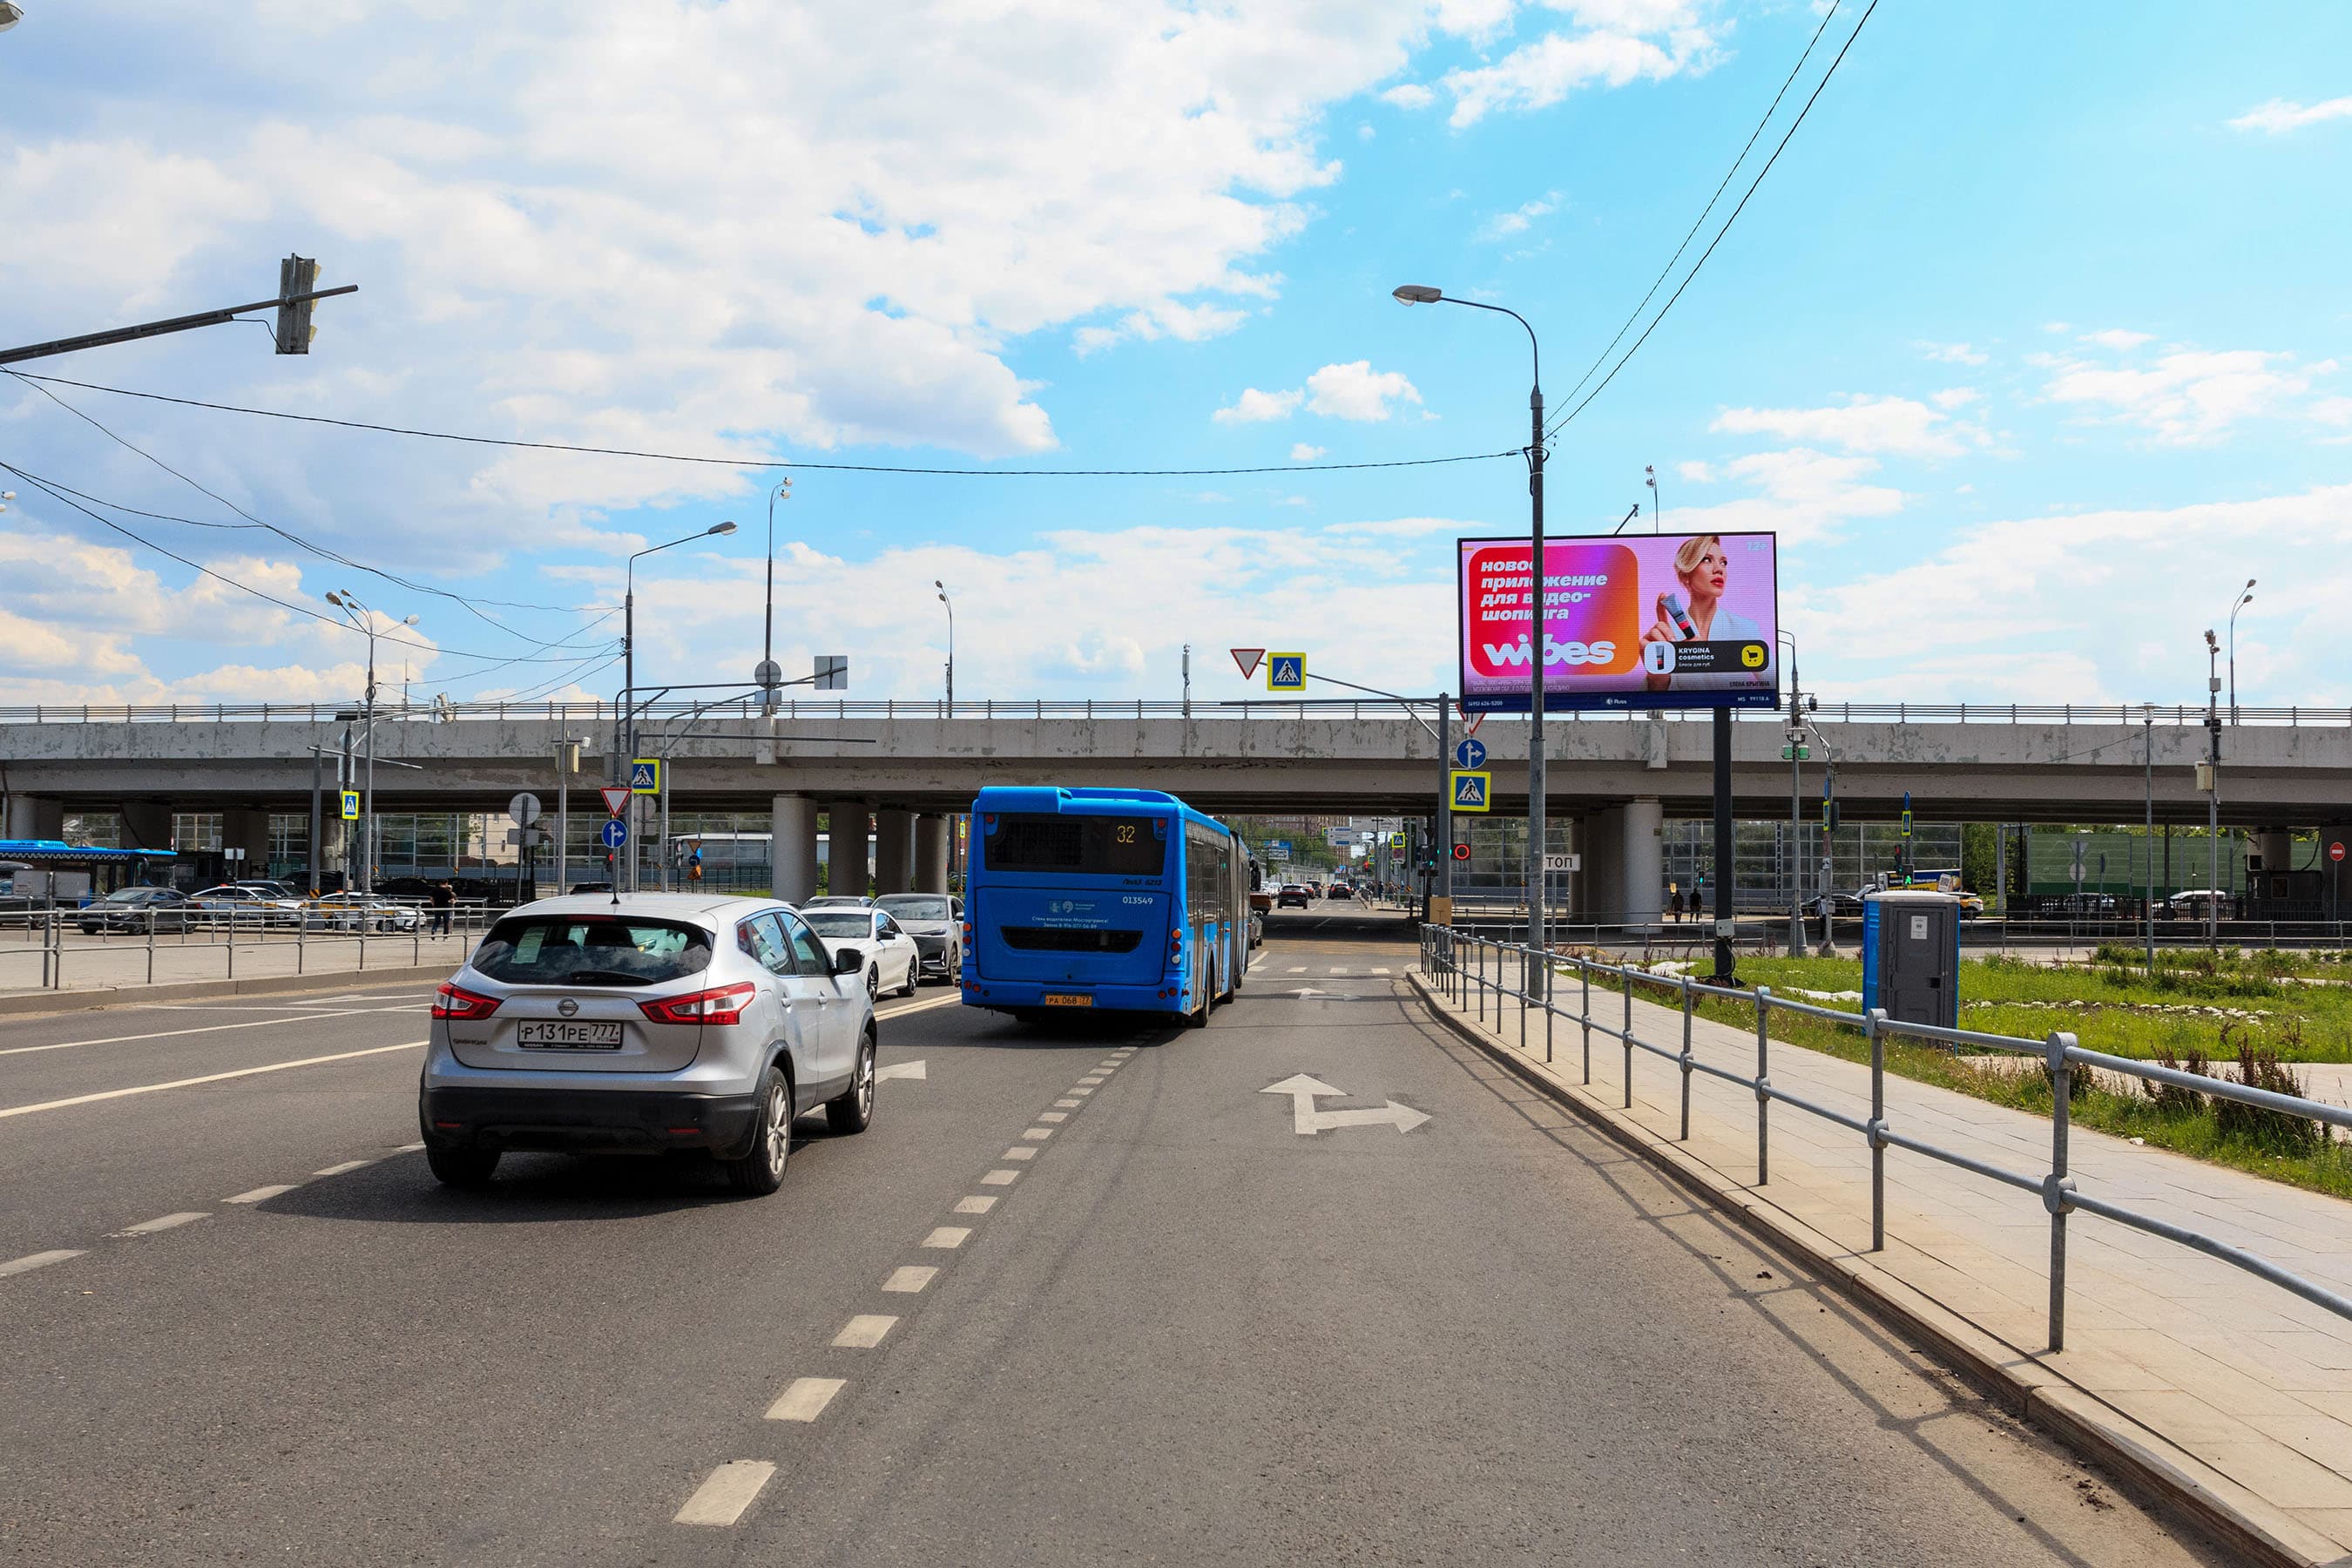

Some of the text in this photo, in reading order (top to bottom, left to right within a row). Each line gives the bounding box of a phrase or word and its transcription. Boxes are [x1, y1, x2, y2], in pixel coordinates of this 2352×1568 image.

[1481, 560, 1533, 572] ново
[1481, 574, 1608, 592] прилжение
[1480, 591, 1592, 607] для вдео-
[1483, 633, 1617, 666] wibes
[1117, 826, 1136, 843] 32
[1545, 856, 1573, 868] ТОП
[1122, 896, 1153, 905] 013549
[1062, 996, 1077, 1004] 068
[524, 1024, 617, 1041] Р131РЕ 777
